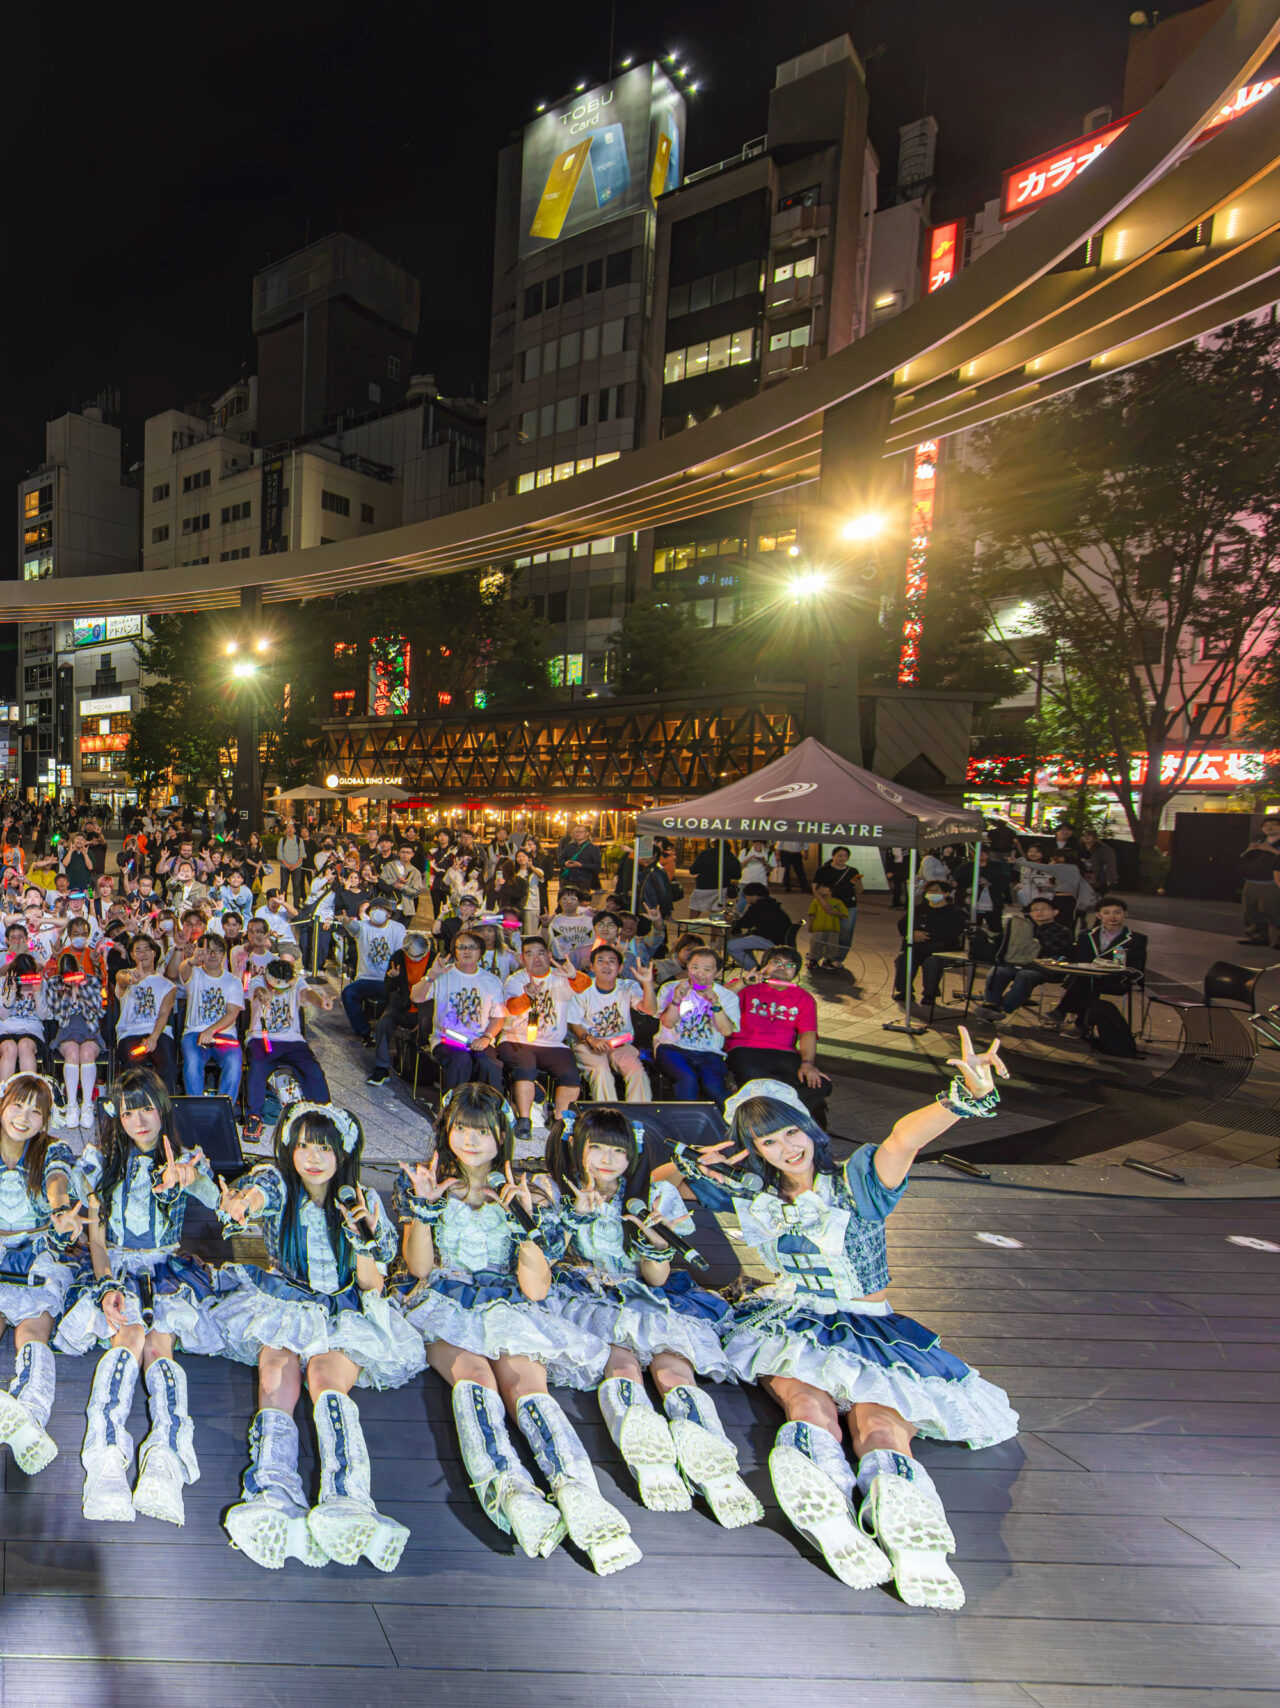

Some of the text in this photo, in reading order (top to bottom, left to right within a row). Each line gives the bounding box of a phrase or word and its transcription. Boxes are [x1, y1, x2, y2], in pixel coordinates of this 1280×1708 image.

[559, 90, 614, 126] TOBU
[569, 113, 600, 136] Card
[108, 624, 140, 638] アドバンス
[339, 777, 403, 785] GLOBAL RING CAFE
[662, 817, 884, 838] GLOBAL RING THEATRE
